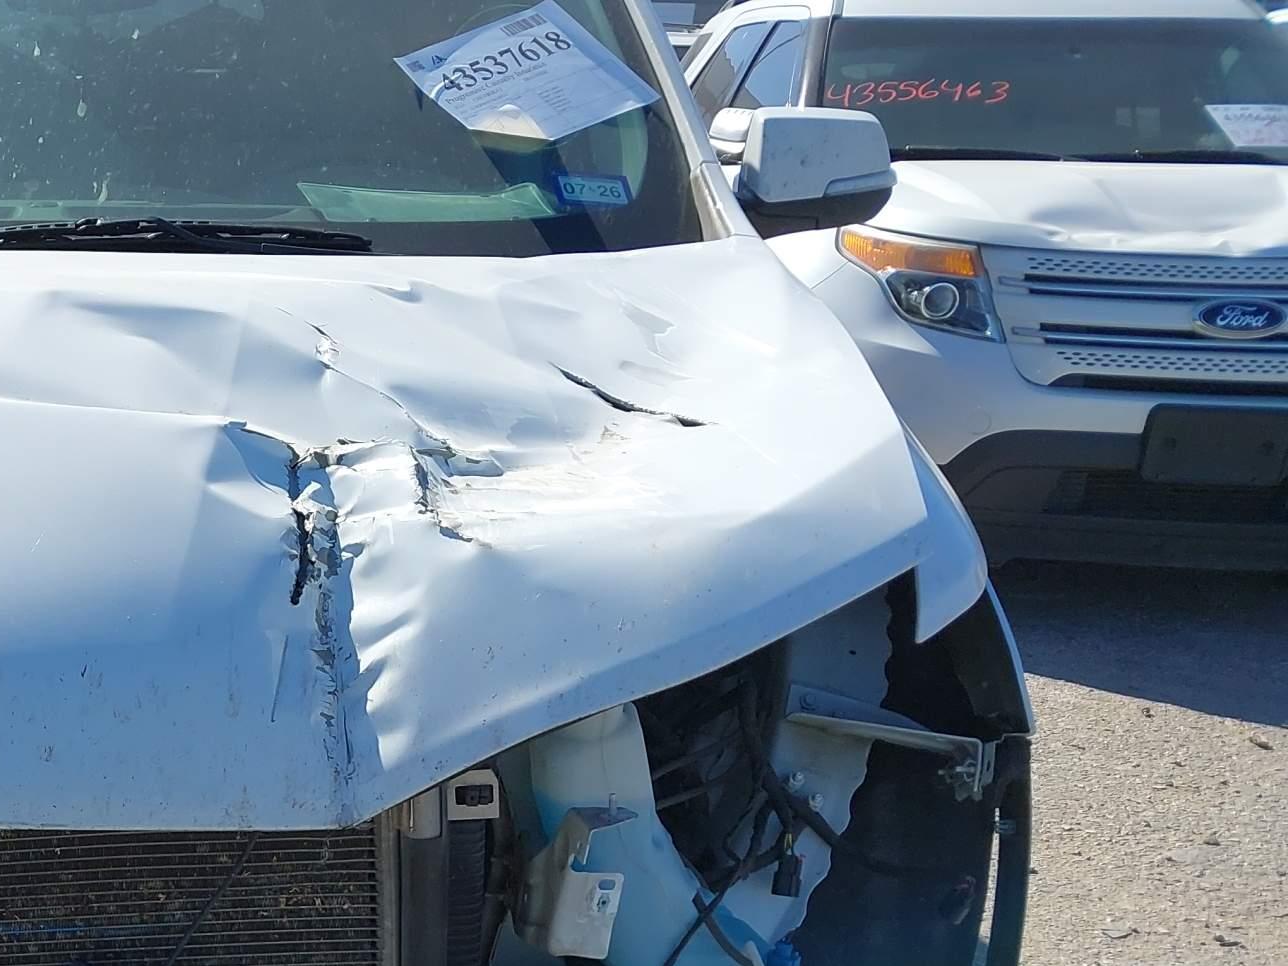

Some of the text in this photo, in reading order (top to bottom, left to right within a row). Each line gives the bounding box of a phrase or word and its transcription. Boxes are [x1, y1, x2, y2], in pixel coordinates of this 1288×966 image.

[442, 31, 572, 92] 43537618
[826, 79, 1010, 107] 43556463
[1216, 305, 1269, 327] Ford
